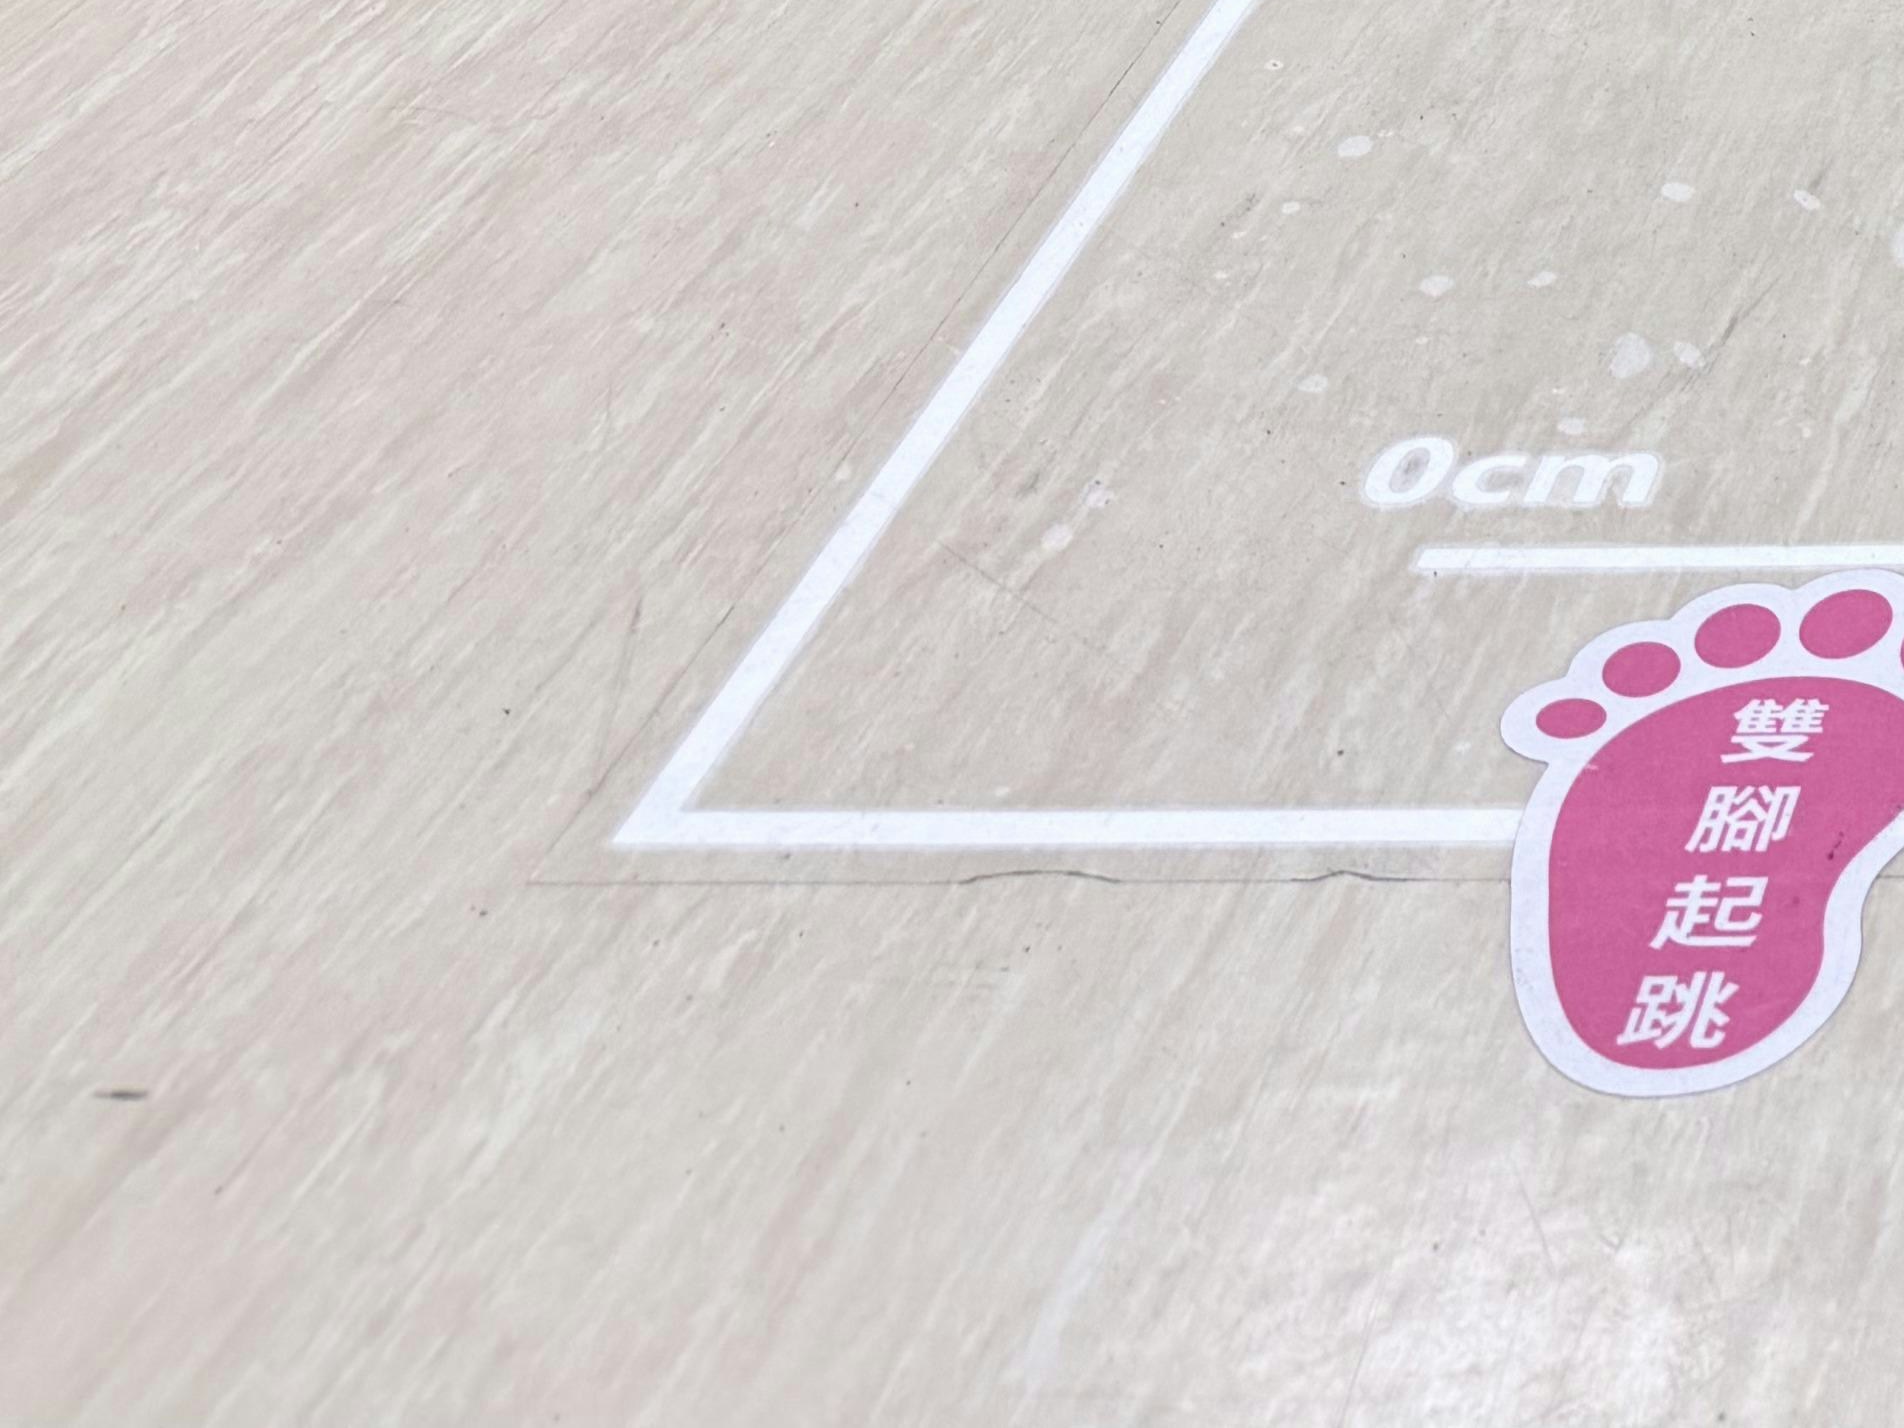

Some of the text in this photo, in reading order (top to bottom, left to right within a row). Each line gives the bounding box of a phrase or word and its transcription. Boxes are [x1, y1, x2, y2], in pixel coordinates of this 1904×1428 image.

[1359, 435, 1663, 510] 0cm
[1617, 697, 1832, 1050] 雙腳起跳
